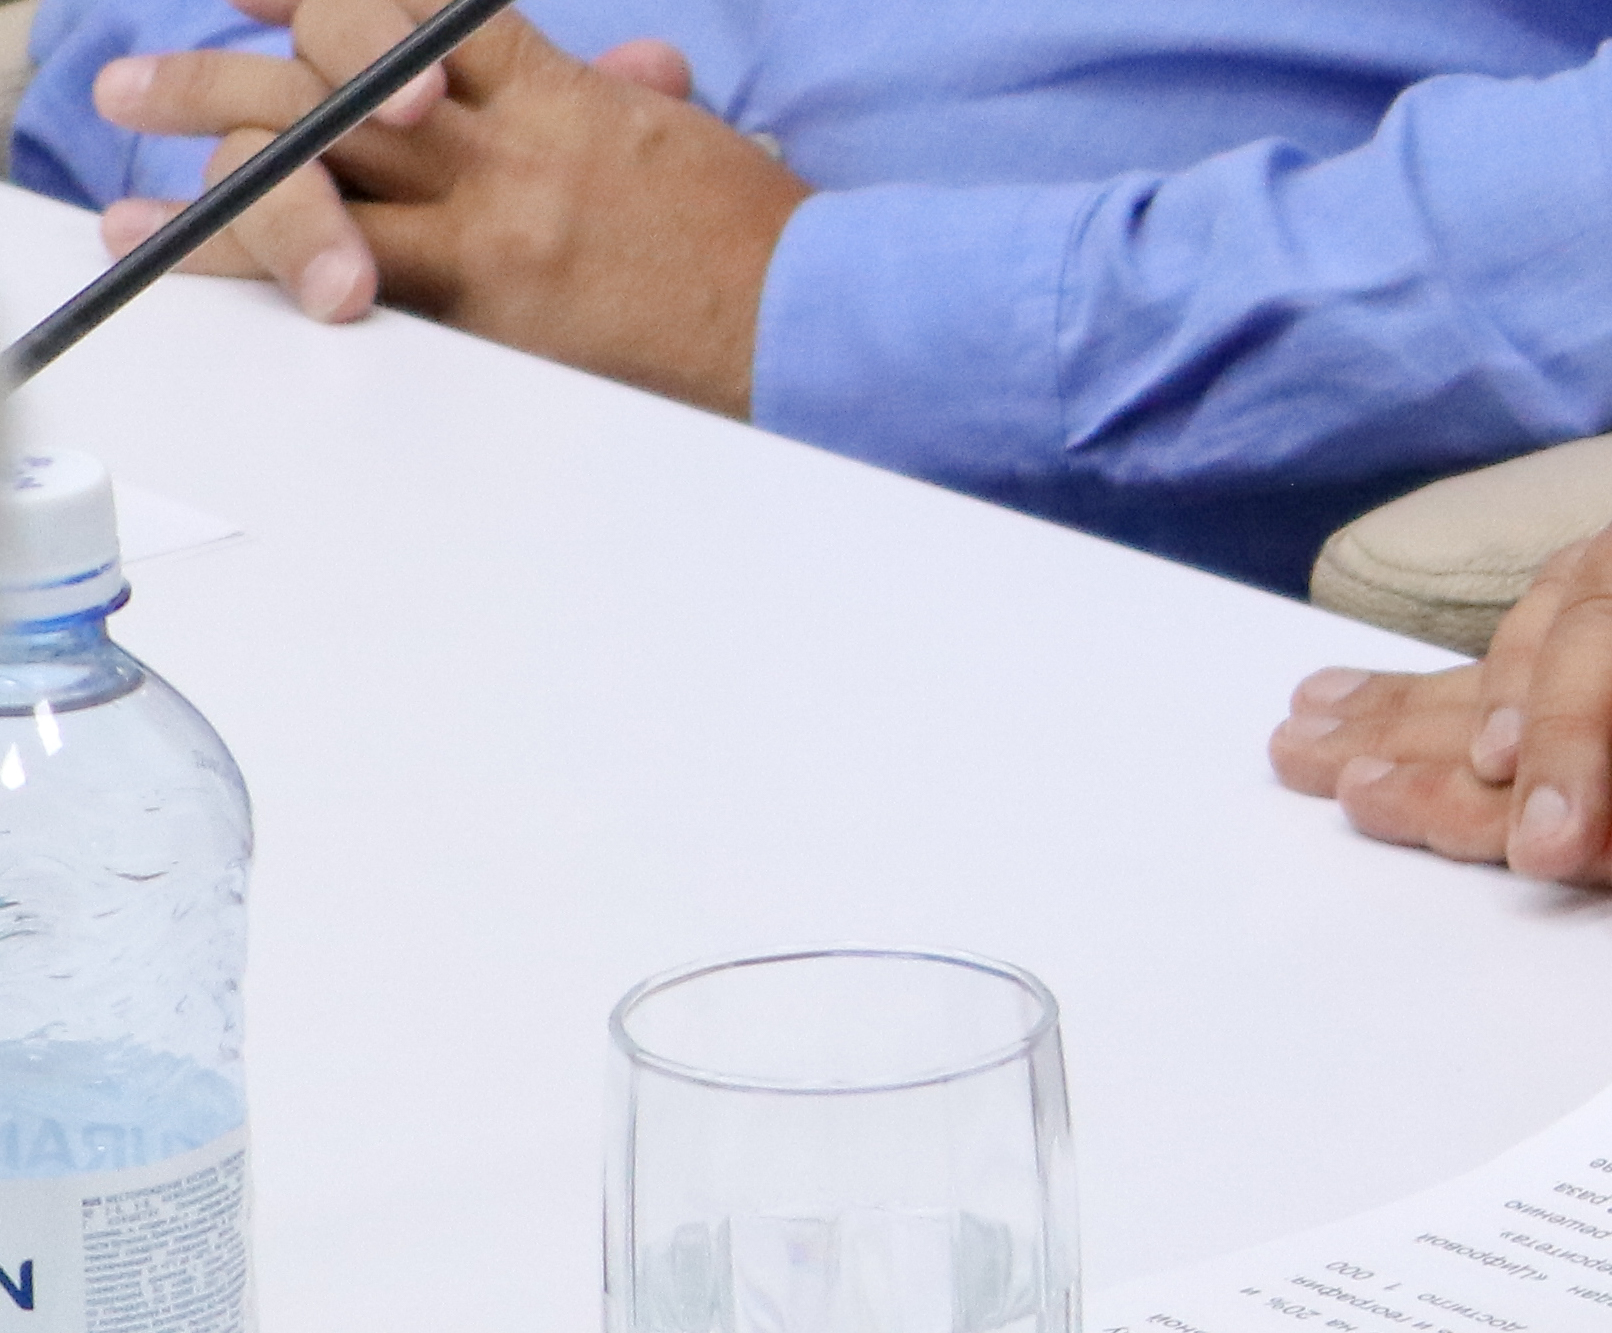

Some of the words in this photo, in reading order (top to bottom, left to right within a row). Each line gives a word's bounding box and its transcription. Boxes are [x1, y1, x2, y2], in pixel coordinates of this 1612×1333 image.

[1553, 1183, 1612, 1205] раза.
[1415, 1233, 1548, 1280] «Цифровой
[1325, 1262, 1375, 1280] 000
[1267, 1298, 1321, 1319] 20%
[1417, 1294, 1527, 1332] достигло
